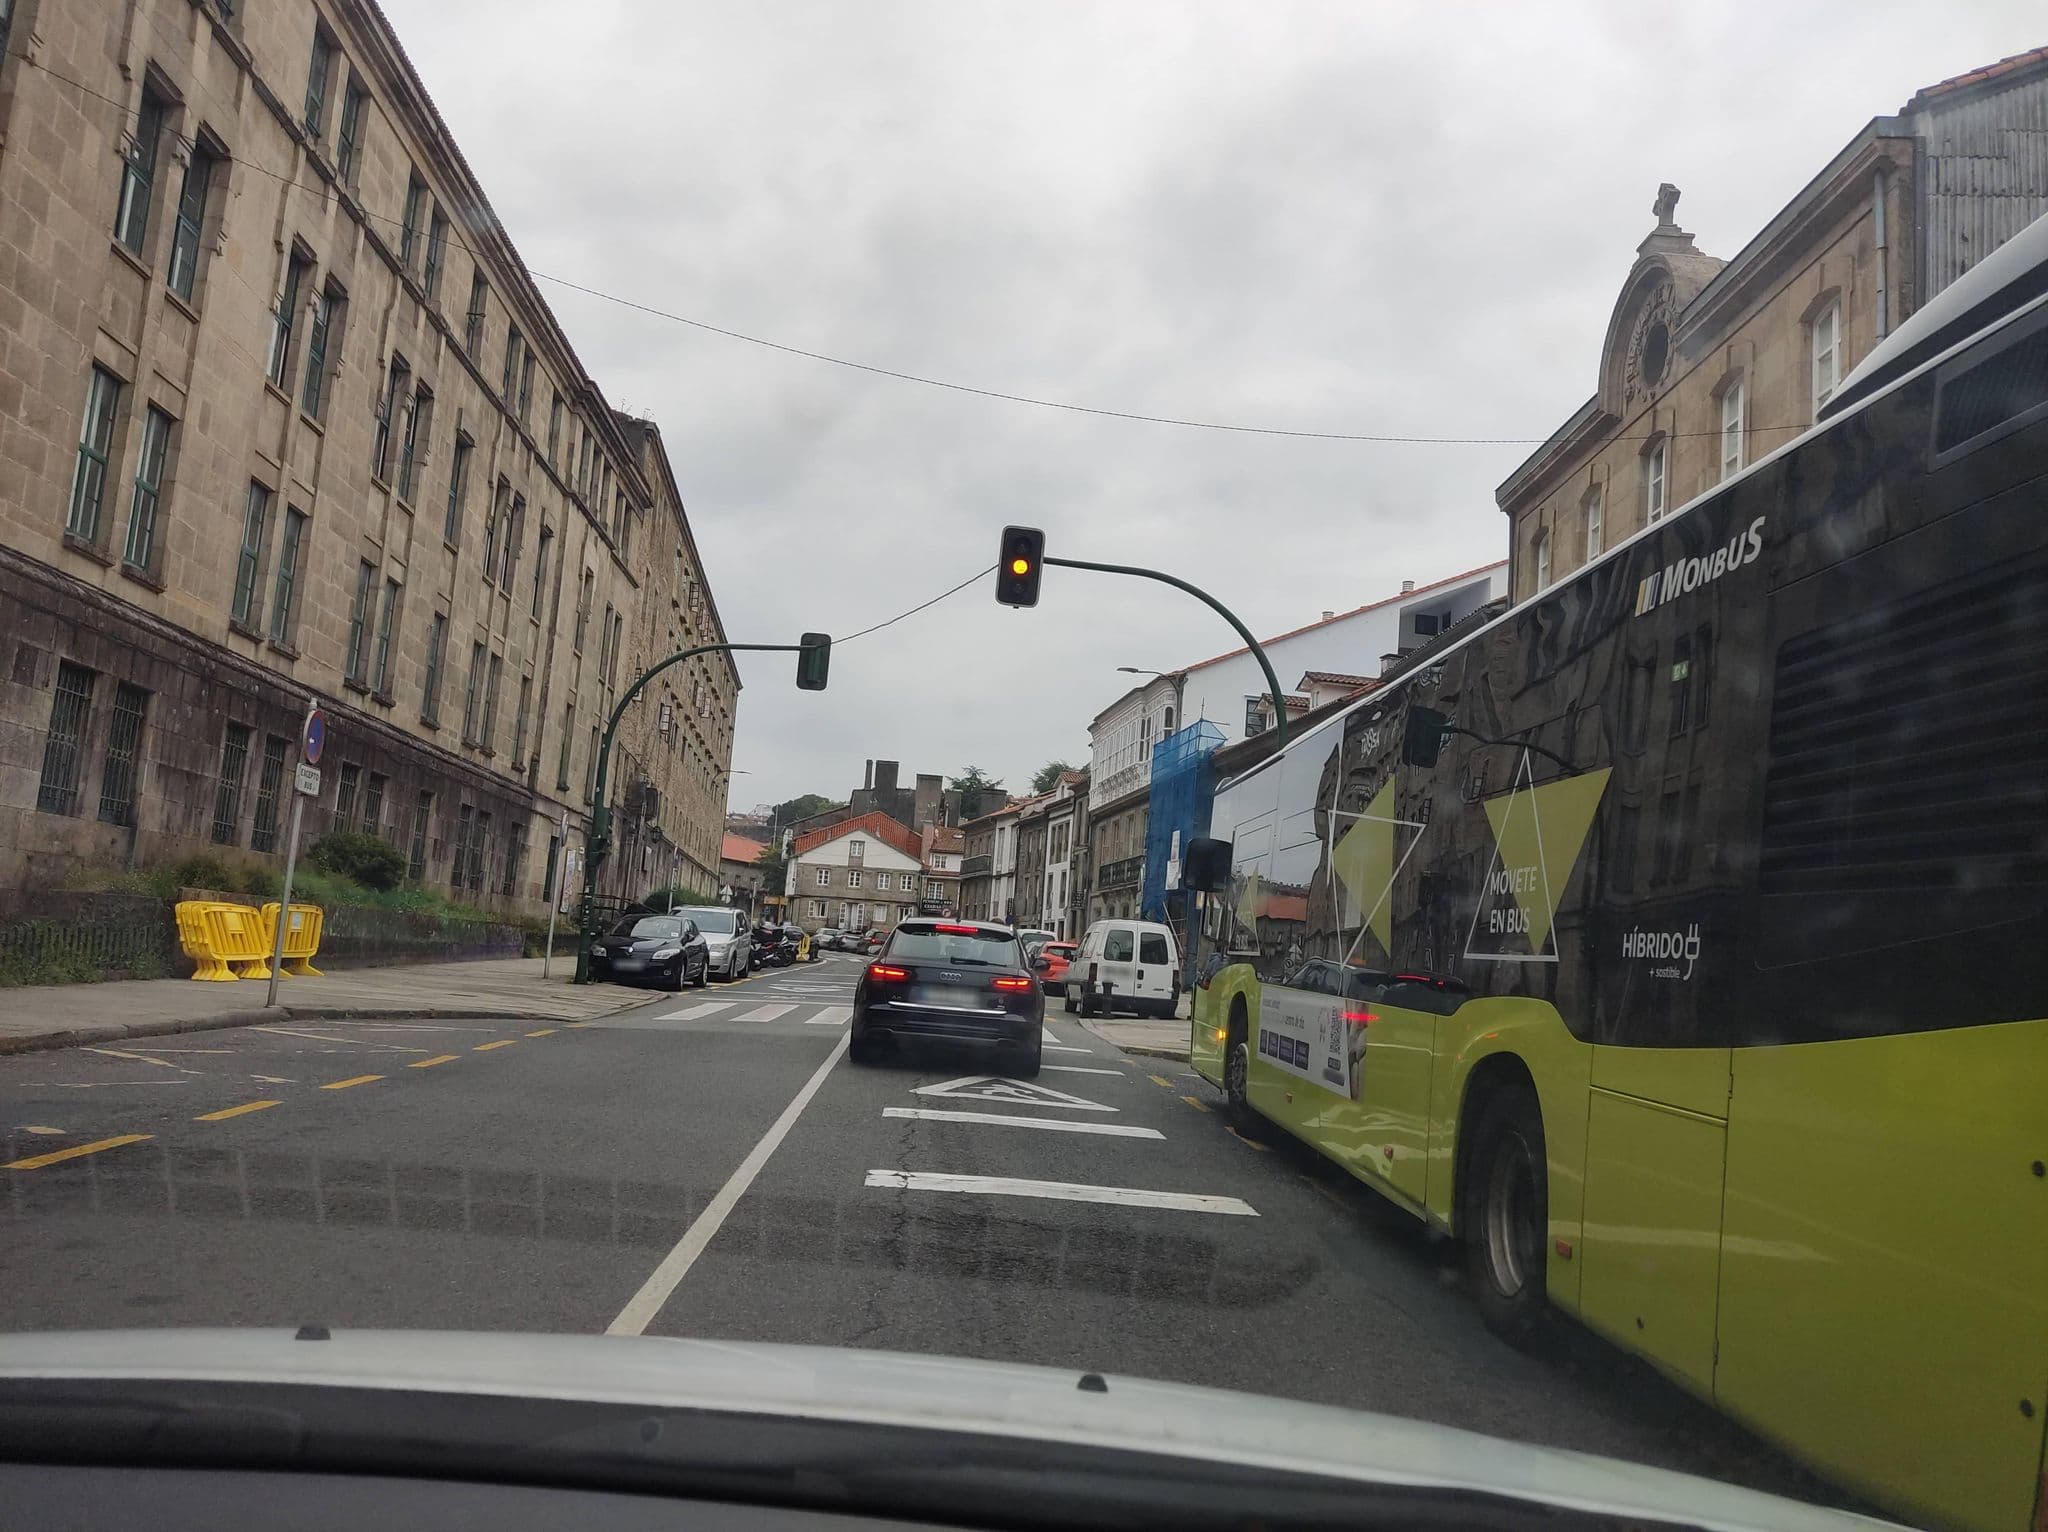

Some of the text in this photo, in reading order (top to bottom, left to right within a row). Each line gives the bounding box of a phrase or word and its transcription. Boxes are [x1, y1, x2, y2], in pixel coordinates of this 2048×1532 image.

[1659, 515, 1766, 606] MONBUS
[1489, 864, 1538, 896] MÓVETE
[1489, 907, 1531, 934] EN BUS
[1622, 925, 1684, 959] HÍBRIDO
